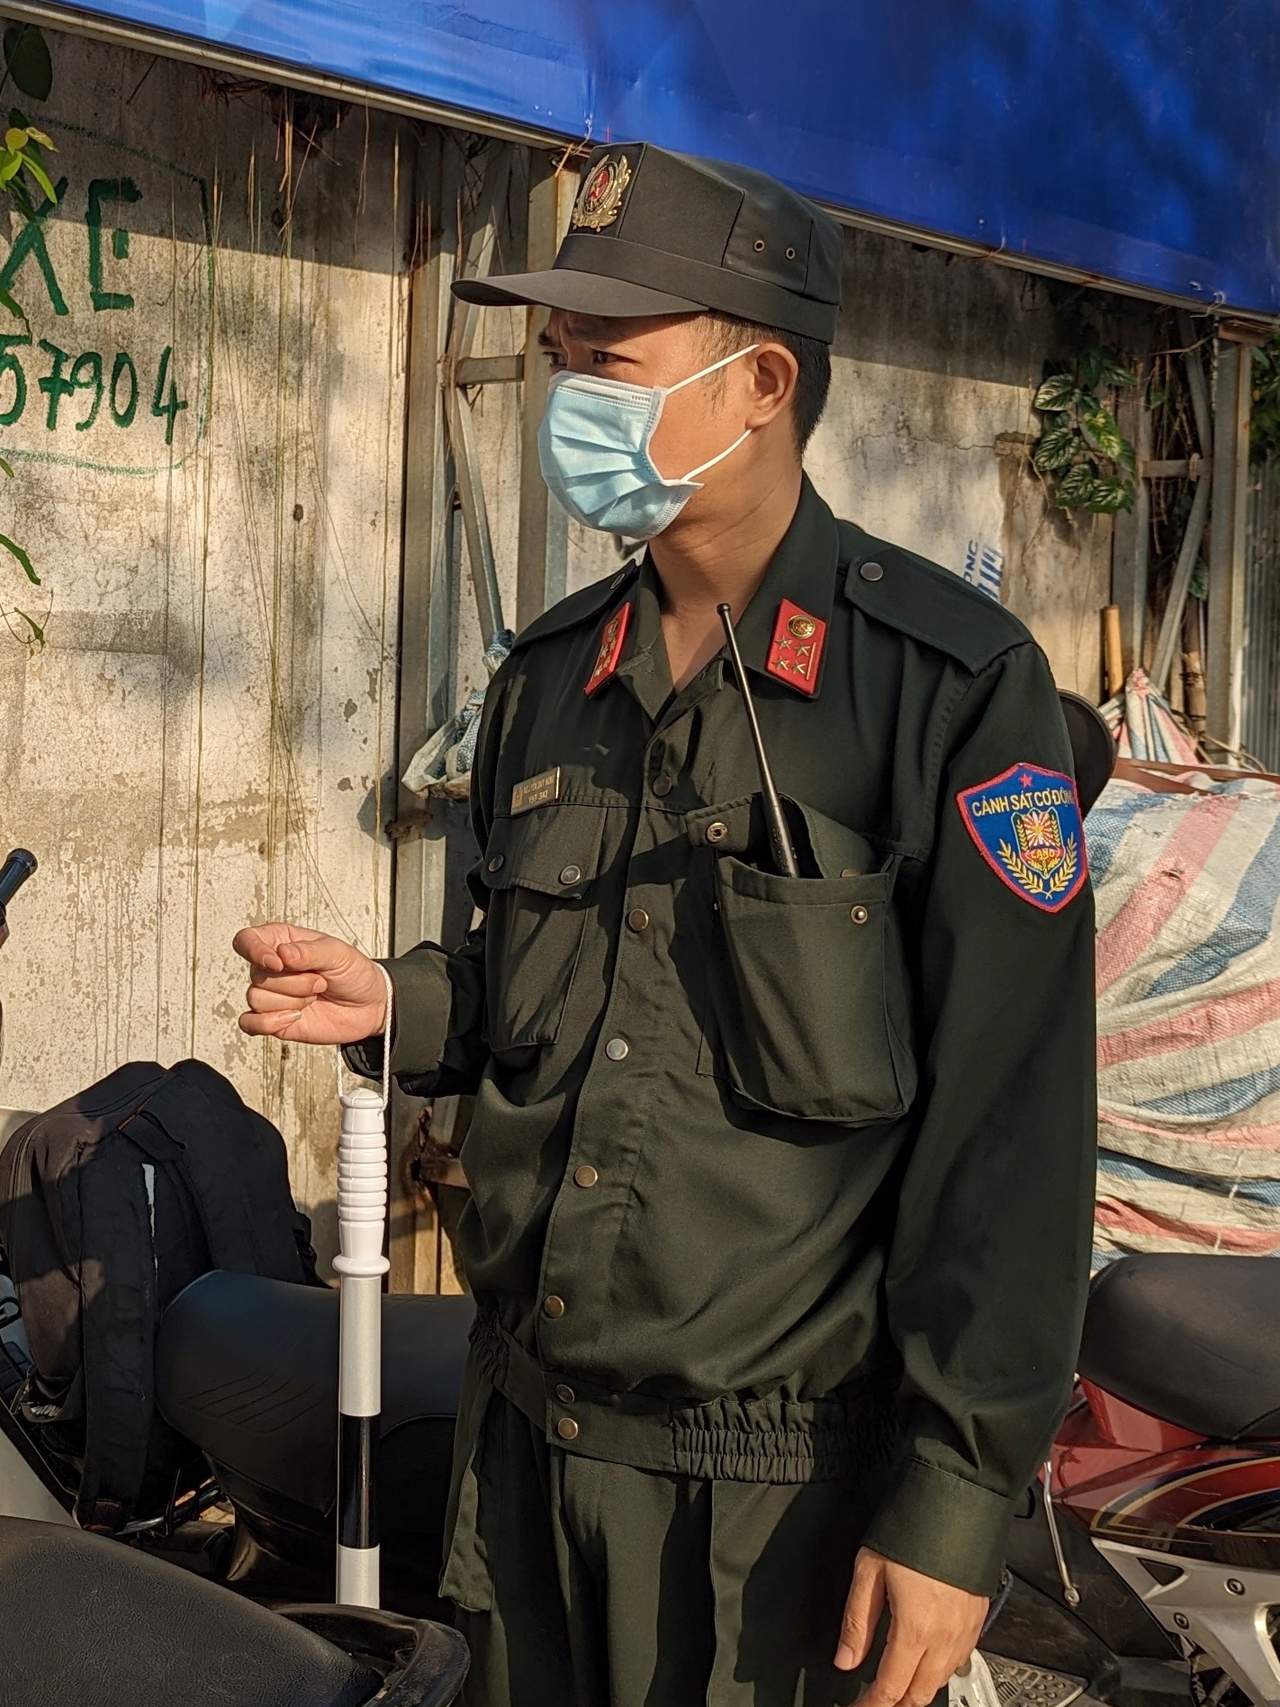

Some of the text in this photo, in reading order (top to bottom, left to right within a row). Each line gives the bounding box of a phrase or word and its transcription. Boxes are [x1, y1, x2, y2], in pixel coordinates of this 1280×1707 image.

[972, 794, 1010, 817] CẢNH
[1010, 790, 1034, 811] SÁT
[1034, 786, 1052, 807] CƠ
